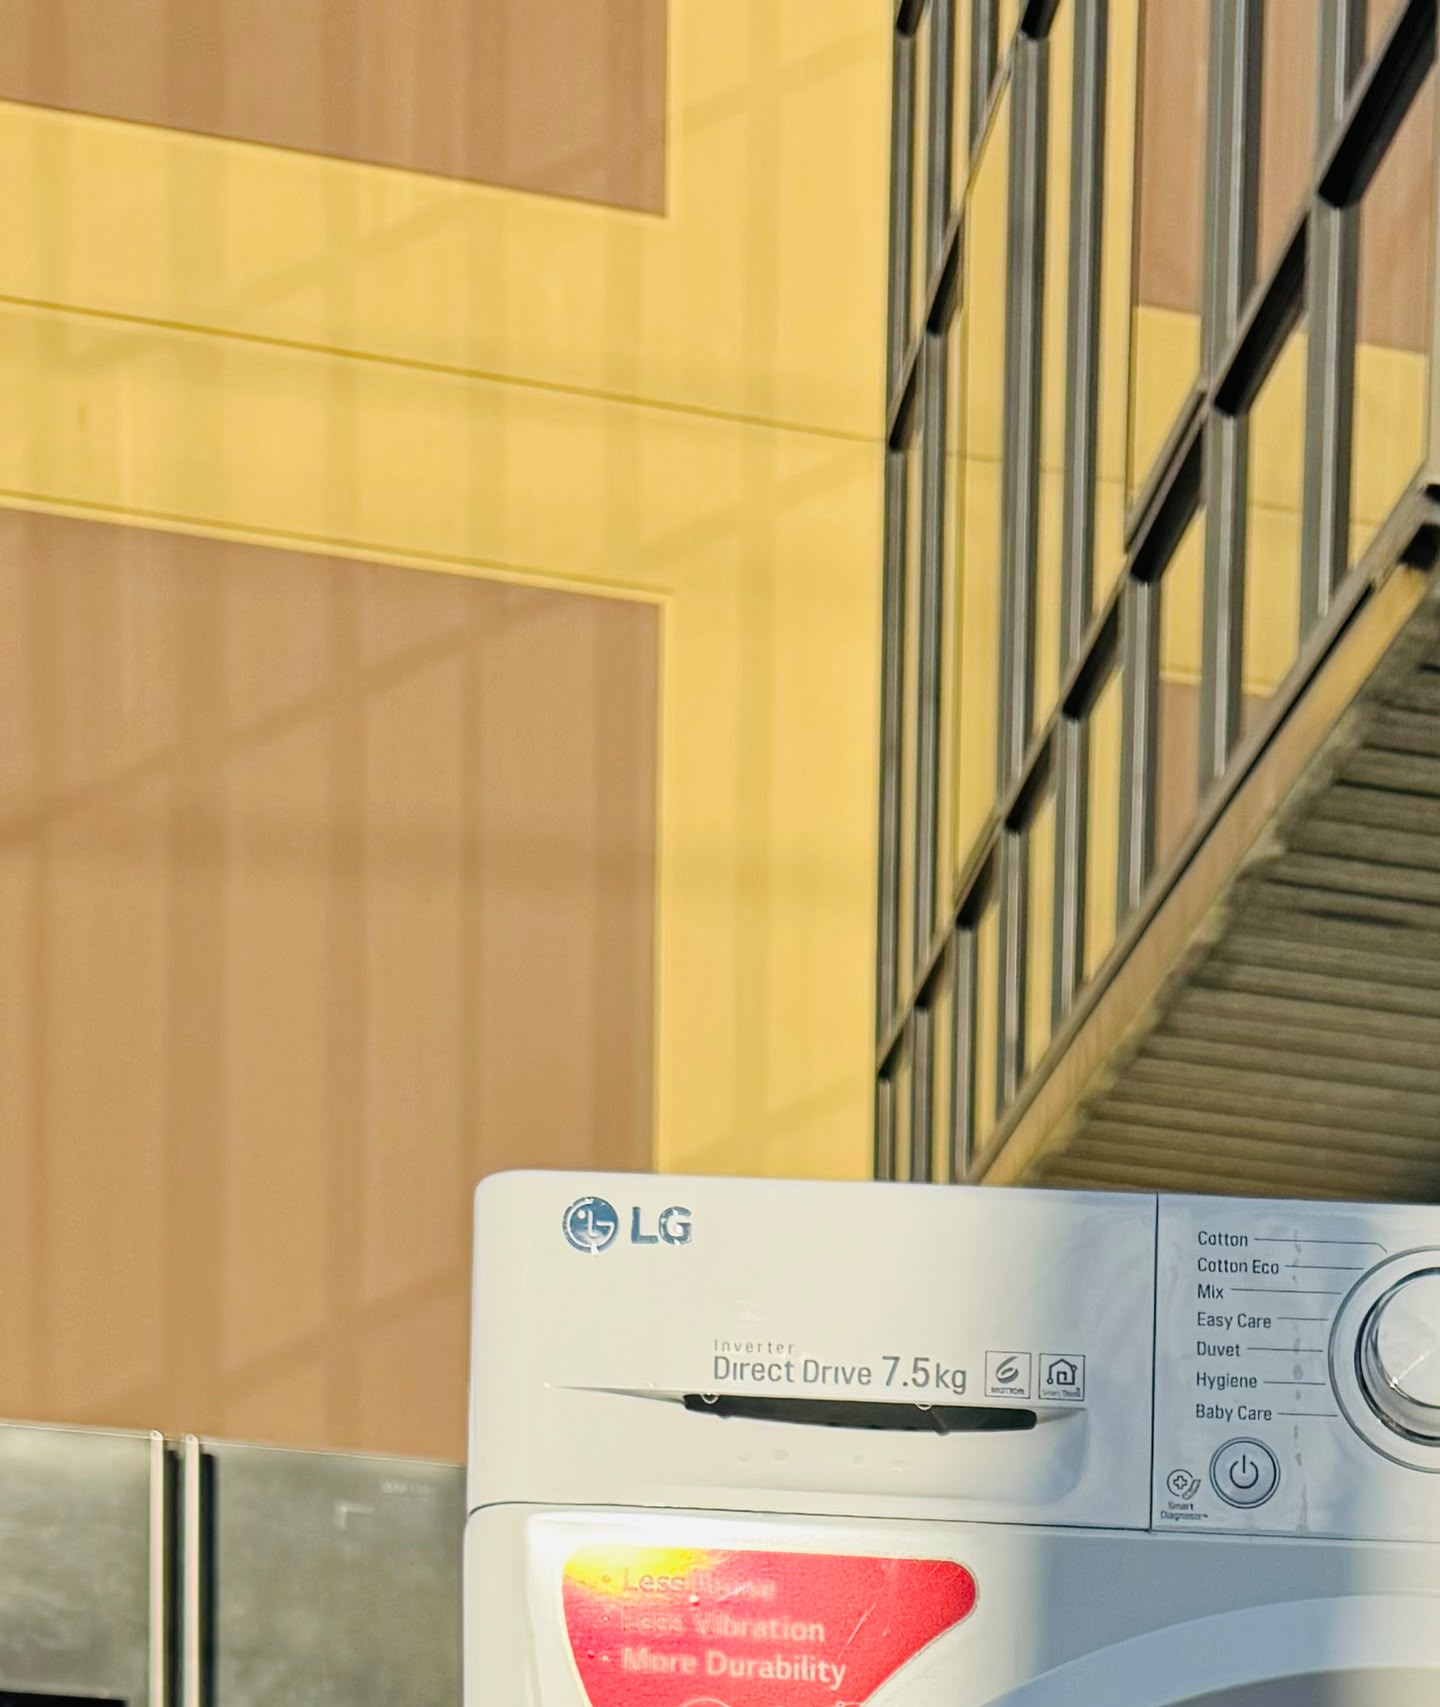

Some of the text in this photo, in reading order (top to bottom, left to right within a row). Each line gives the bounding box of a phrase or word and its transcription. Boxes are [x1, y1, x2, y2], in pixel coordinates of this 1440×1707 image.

[631, 1206, 692, 1246] LG
[1198, 1231, 1248, 1248] Cotton
[1198, 1258, 1279, 1275] Cotton Eco
[1198, 1284, 1224, 1300] Mix
[1197, 1312, 1272, 1331] Easy Care
[714, 1338, 795, 1354] Inverter
[1196, 1342, 1240, 1358] Duvet
[714, 1356, 795, 1383] Direct
[803, 1359, 872, 1386] Drive
[1196, 1373, 1258, 1392] Hygiene
[1196, 1404, 1272, 1424] Baby Care
[621, 1568, 686, 1592] Less
[622, 1606, 825, 1642] Less Vibration
[621, 1647, 846, 1691] More Durability
